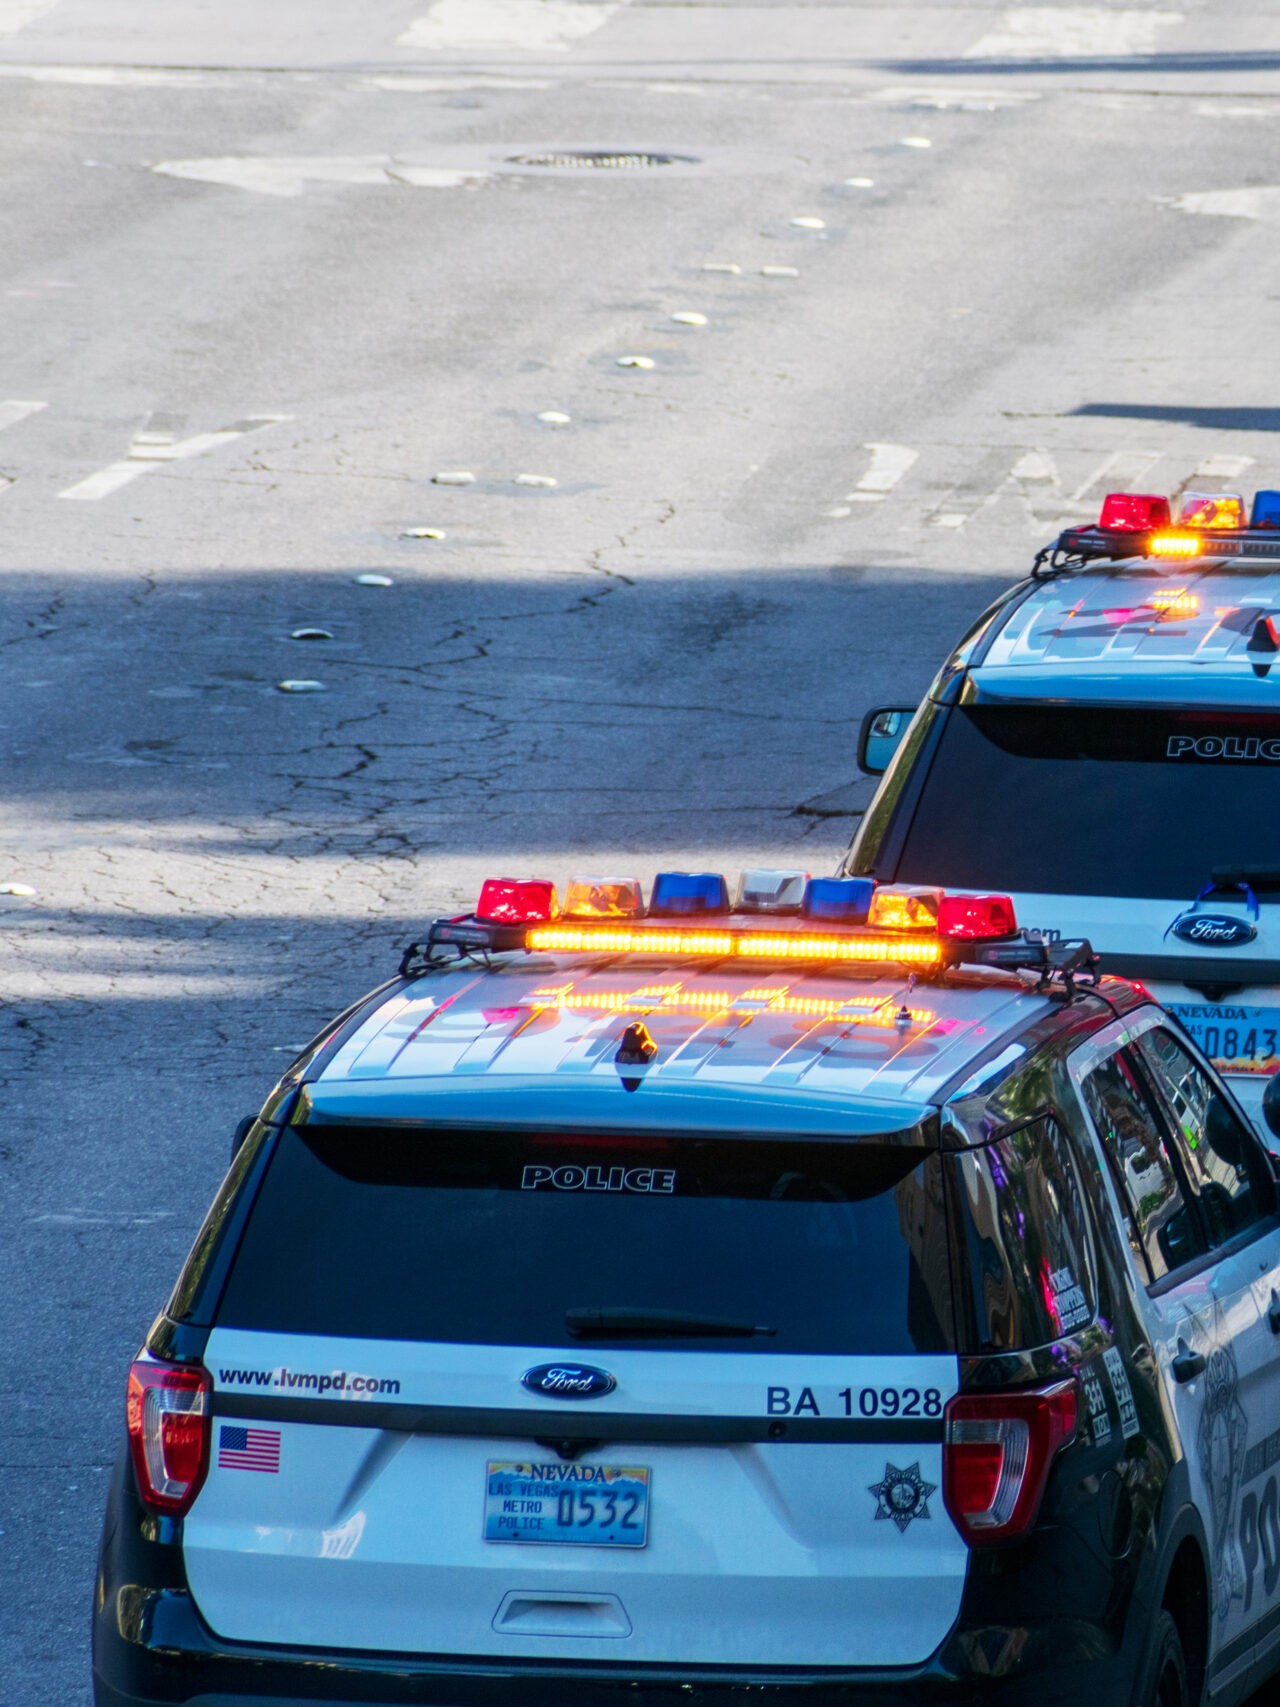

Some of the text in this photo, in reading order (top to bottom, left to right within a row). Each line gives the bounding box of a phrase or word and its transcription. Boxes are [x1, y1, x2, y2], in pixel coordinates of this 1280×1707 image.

[1190, 918, 1238, 940] Ford
[1177, 1006, 1249, 1020] NEVADA
[1204, 1026, 1278, 1061] 0843
[521, 1165, 676, 1193] POLICE
[218, 1368, 401, 1395] www.lvmpd.com
[541, 1367, 594, 1391] Ford
[766, 1386, 943, 1417] BA 10928
[529, 1464, 607, 1482] NEVADA
[488, 1483, 560, 1498] LAS VEGAS
[503, 1500, 542, 1513] METRO
[556, 1489, 640, 1530] 0532
[497, 1516, 545, 1530] POLICE
